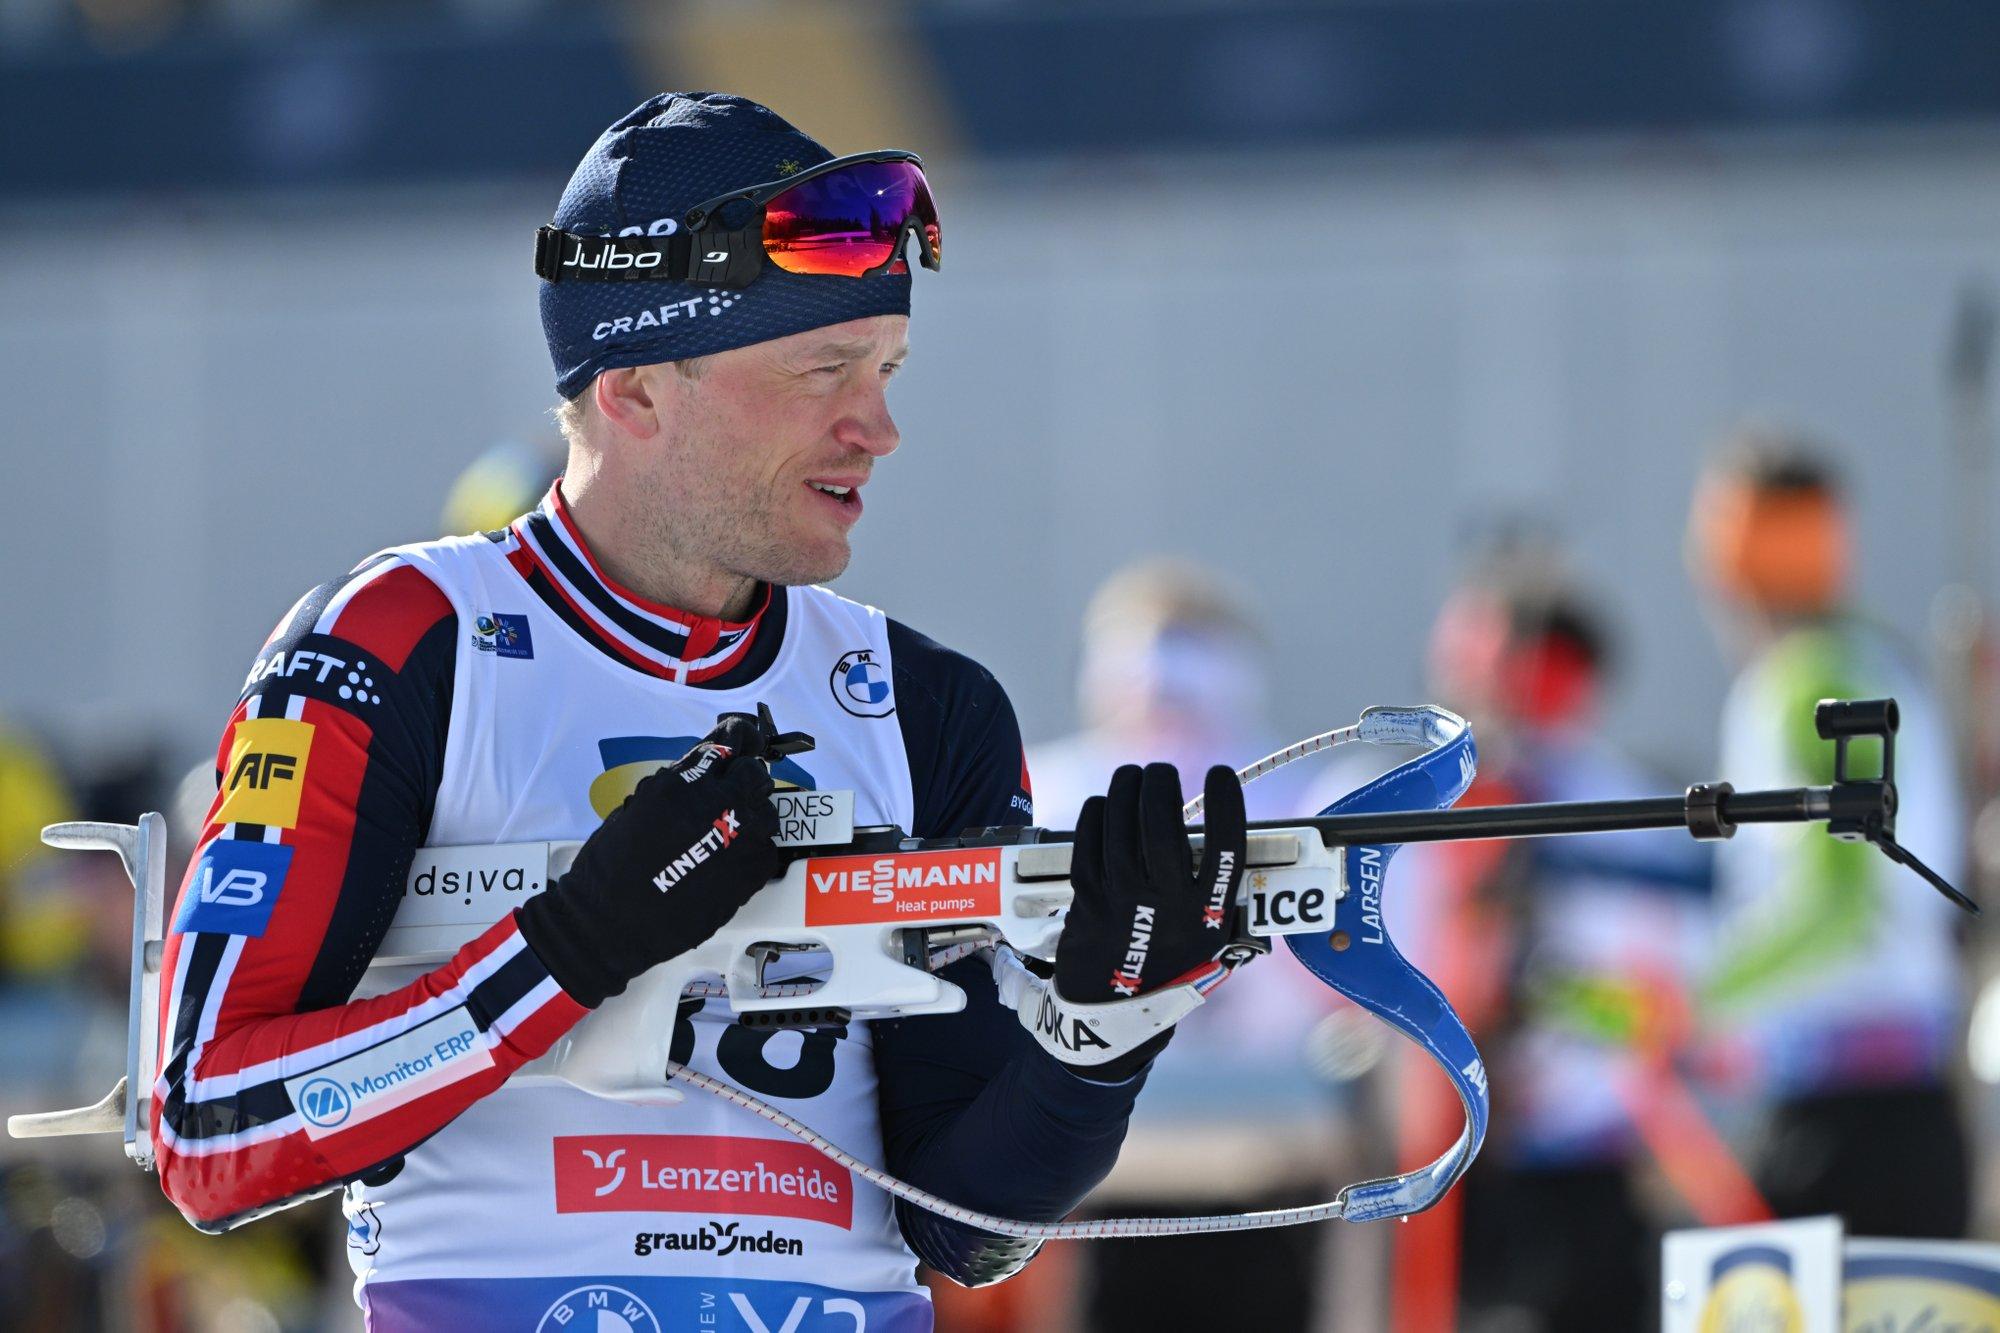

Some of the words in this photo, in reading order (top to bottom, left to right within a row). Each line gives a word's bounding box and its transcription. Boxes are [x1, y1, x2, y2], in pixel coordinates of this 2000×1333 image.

[563, 243, 662, 269] Julbo
[592, 297, 703, 340] CRAFT
[241, 650, 346, 693] RAFT
[229, 753, 298, 790] AF
[201, 866, 268, 907] VB
[812, 859, 996, 904] VIESSMANN
[1252, 874, 1325, 927] ice
[1359, 847, 1384, 945] LARSEN
[896, 901, 926, 913] Heat
[930, 898, 975, 914] pumps
[350, 1053, 434, 1100] Monitor
[433, 1029, 476, 1063] ERP
[641, 1159, 839, 1204] Lenzerheide
[552, 1291, 645, 1326] BMW
[700, 1292, 716, 1333] EW
